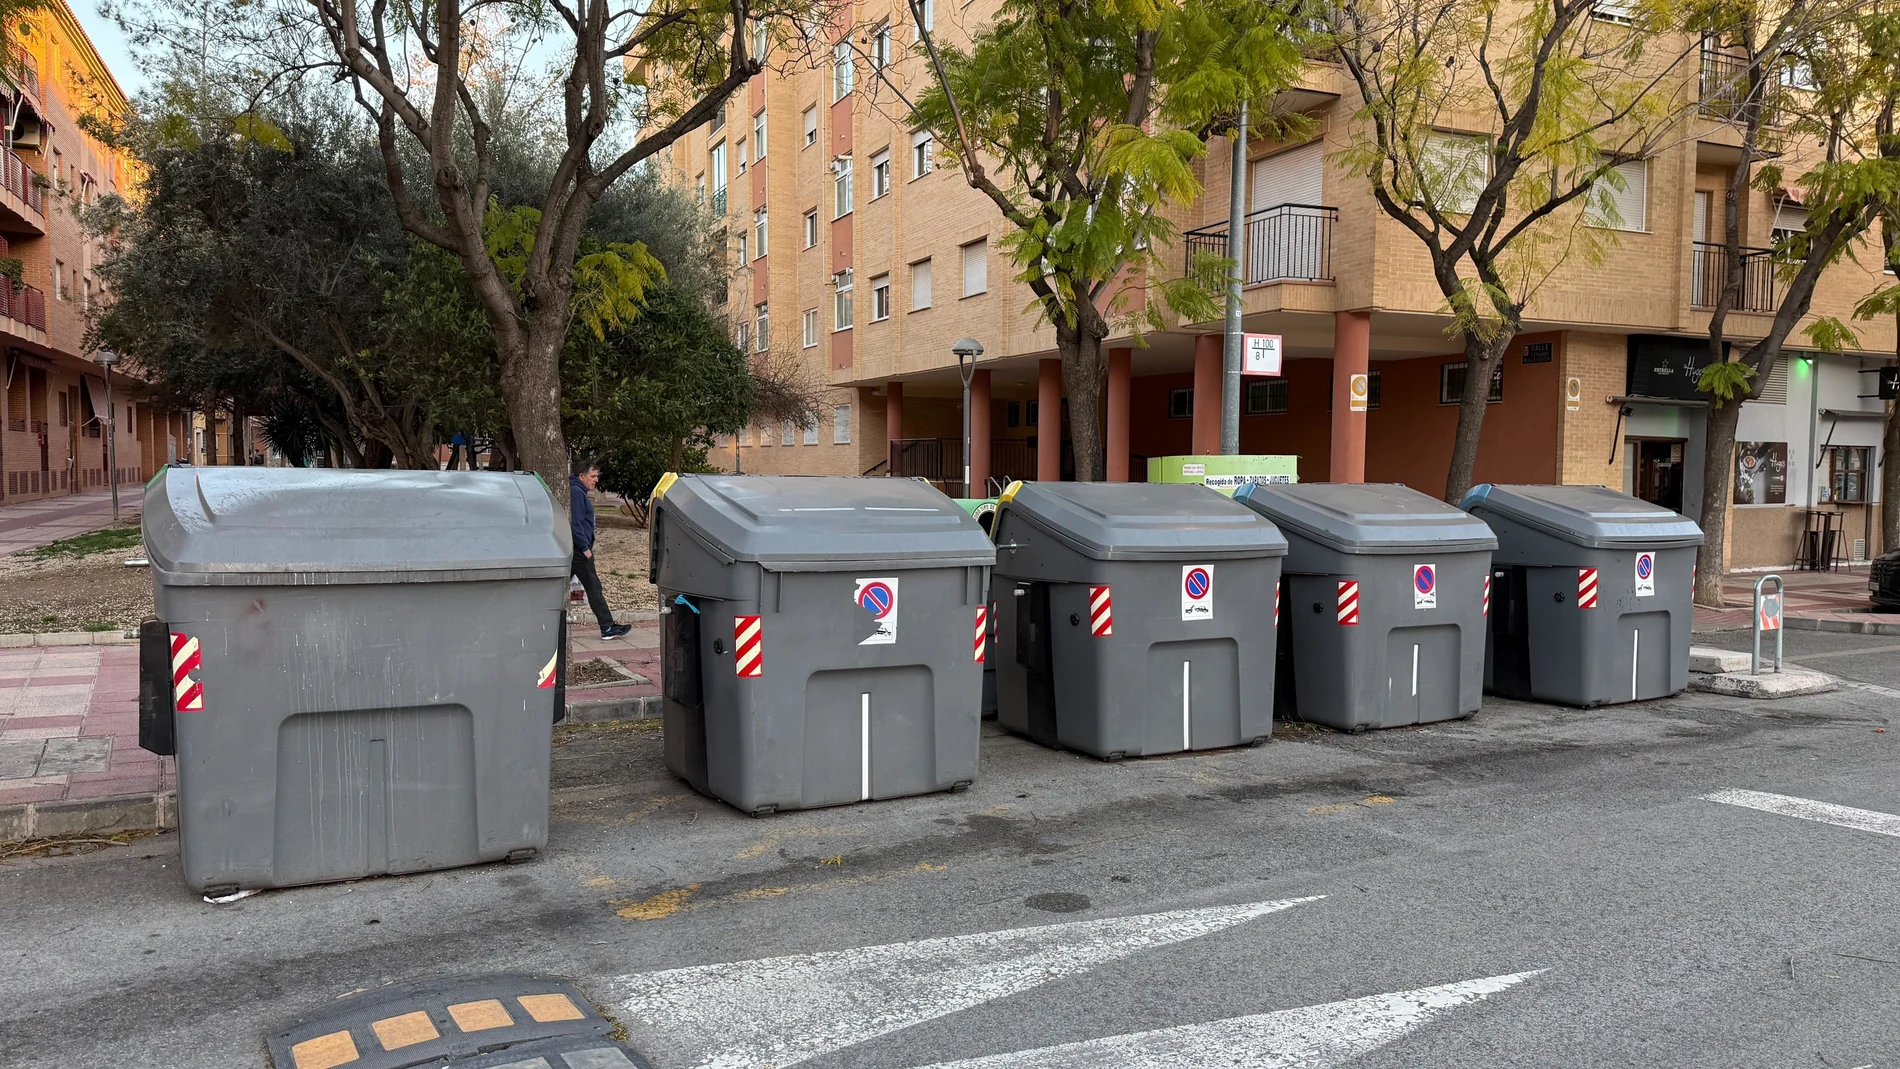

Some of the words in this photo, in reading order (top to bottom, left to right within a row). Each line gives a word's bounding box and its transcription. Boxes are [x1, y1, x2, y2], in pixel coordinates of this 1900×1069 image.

[1254, 339, 1260, 347] H
[1262, 338, 1274, 348] 100
[1531, 343, 1549, 351] CALLE
[1256, 352, 1260, 360] 8
[1206, 478, 1227, 486] Recogida
[1233, 475, 1246, 485] ROPA
[1269, 475, 1289, 485] JUGUETES
